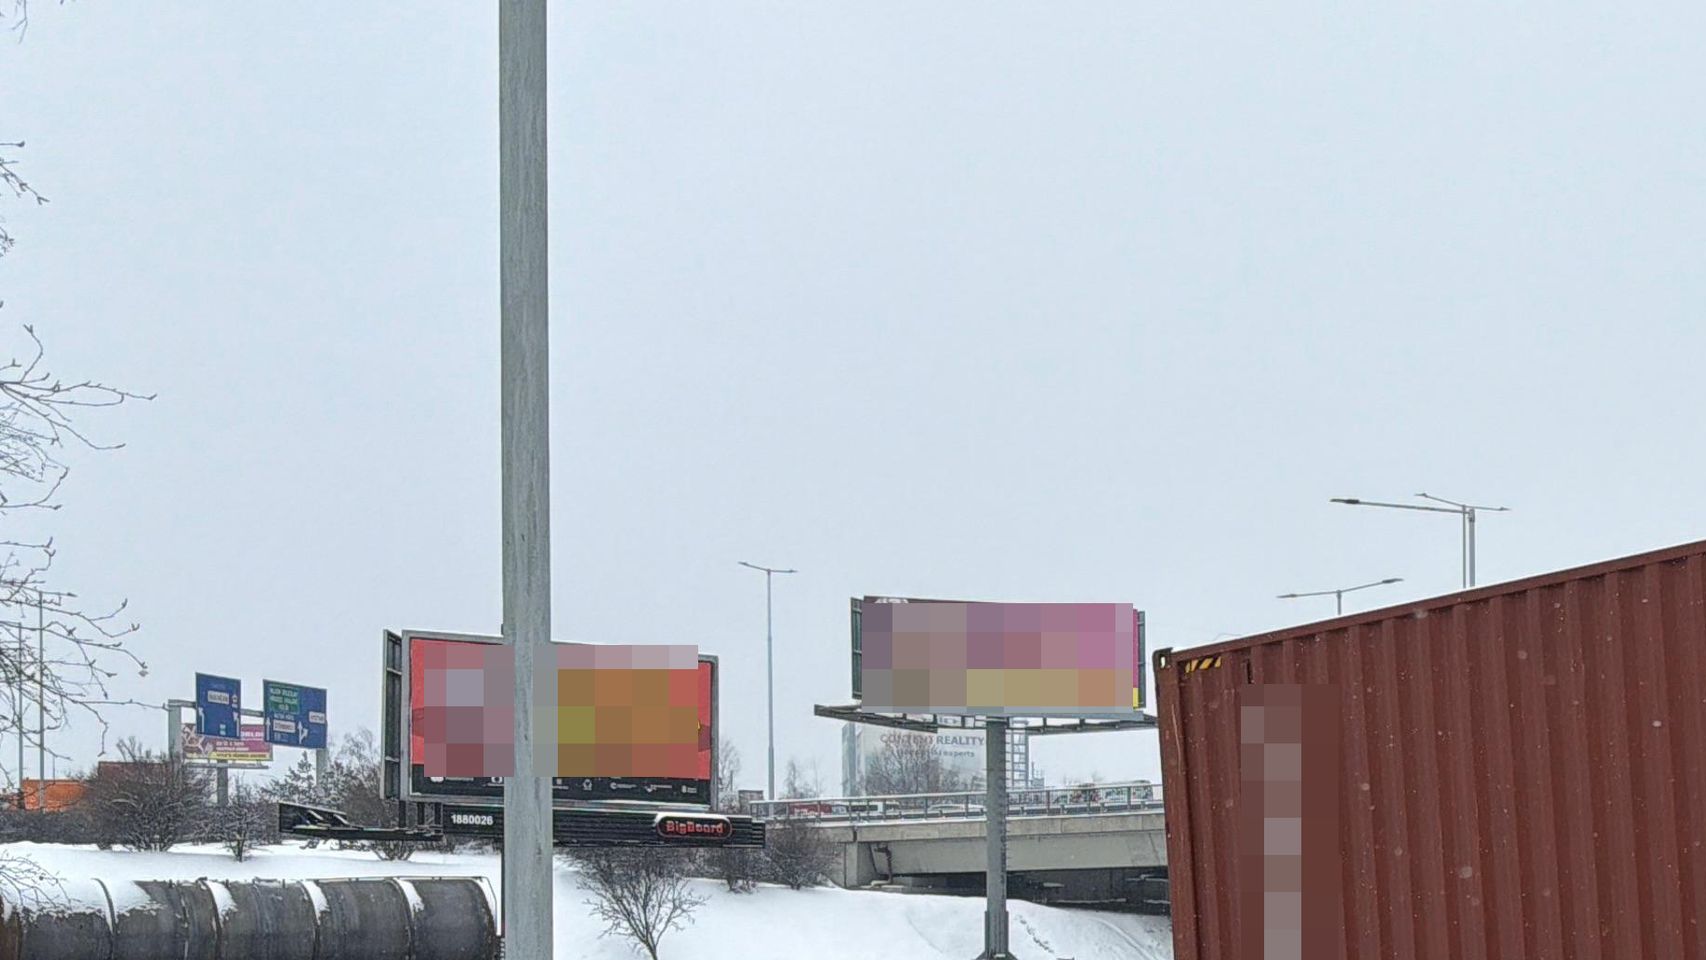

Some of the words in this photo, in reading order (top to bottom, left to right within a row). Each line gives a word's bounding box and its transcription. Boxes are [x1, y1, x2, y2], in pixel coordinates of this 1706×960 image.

[936, 736, 985, 745] REALITY
[451, 814, 493, 826] 1880026
[665, 820, 724, 834] BigBoard
